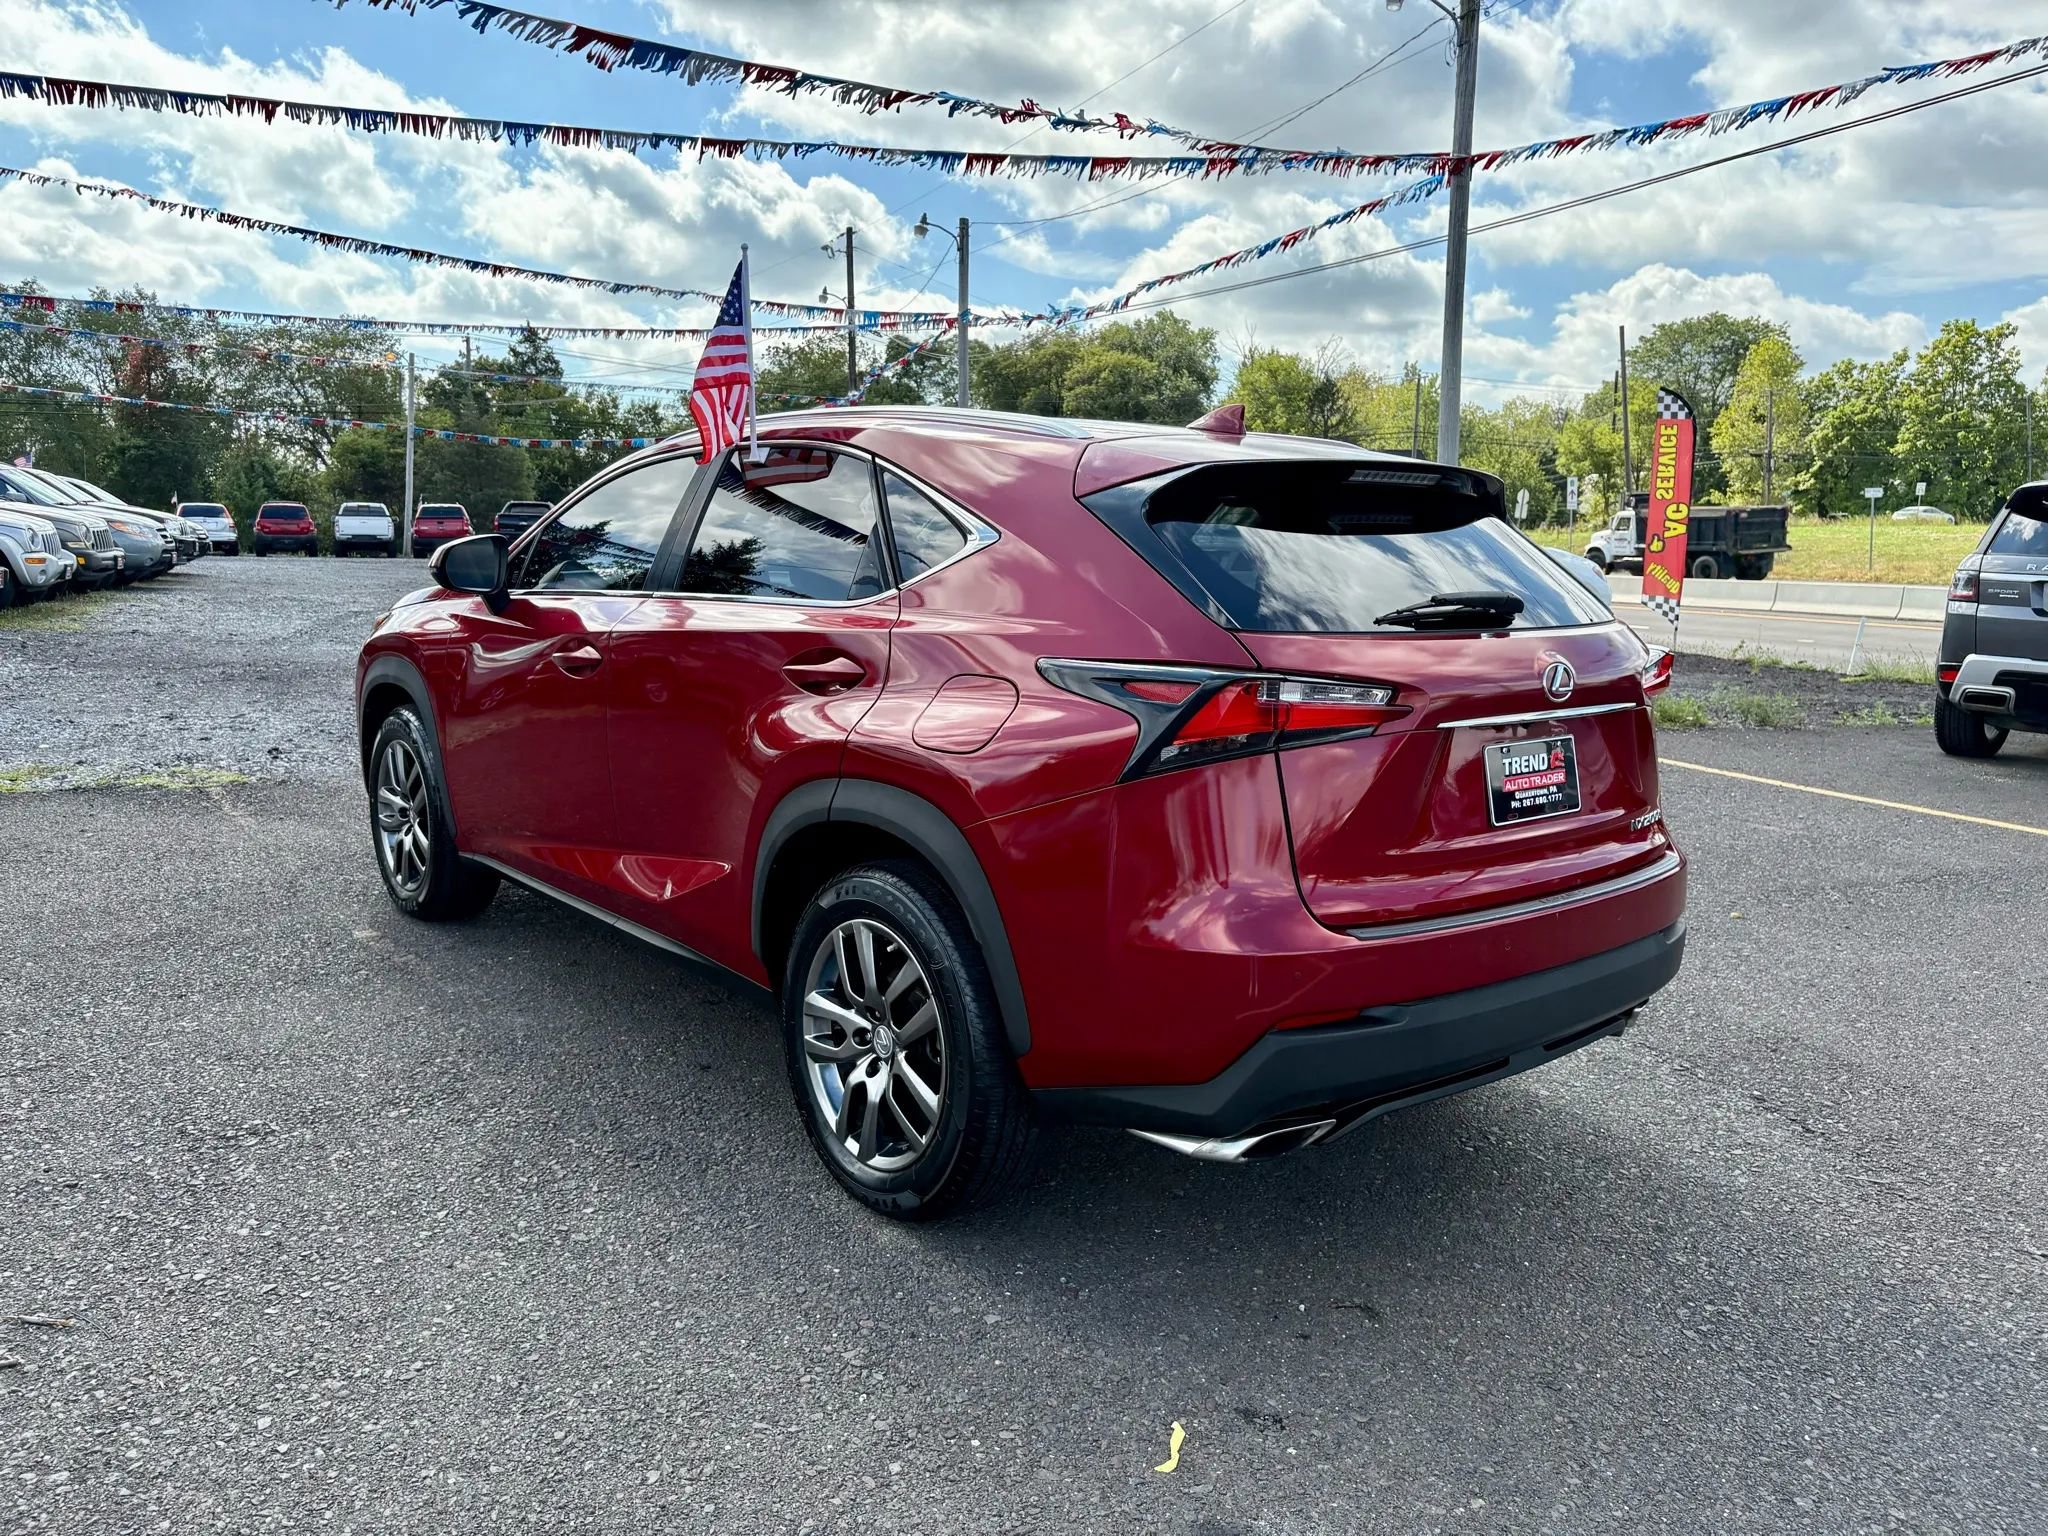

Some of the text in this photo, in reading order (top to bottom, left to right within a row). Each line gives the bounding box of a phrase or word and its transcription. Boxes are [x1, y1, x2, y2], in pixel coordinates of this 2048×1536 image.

[1502, 753, 1548, 775] TREND
[1505, 772, 1564, 791] AUTO TRADER
[1549, 785, 1558, 793] PA
